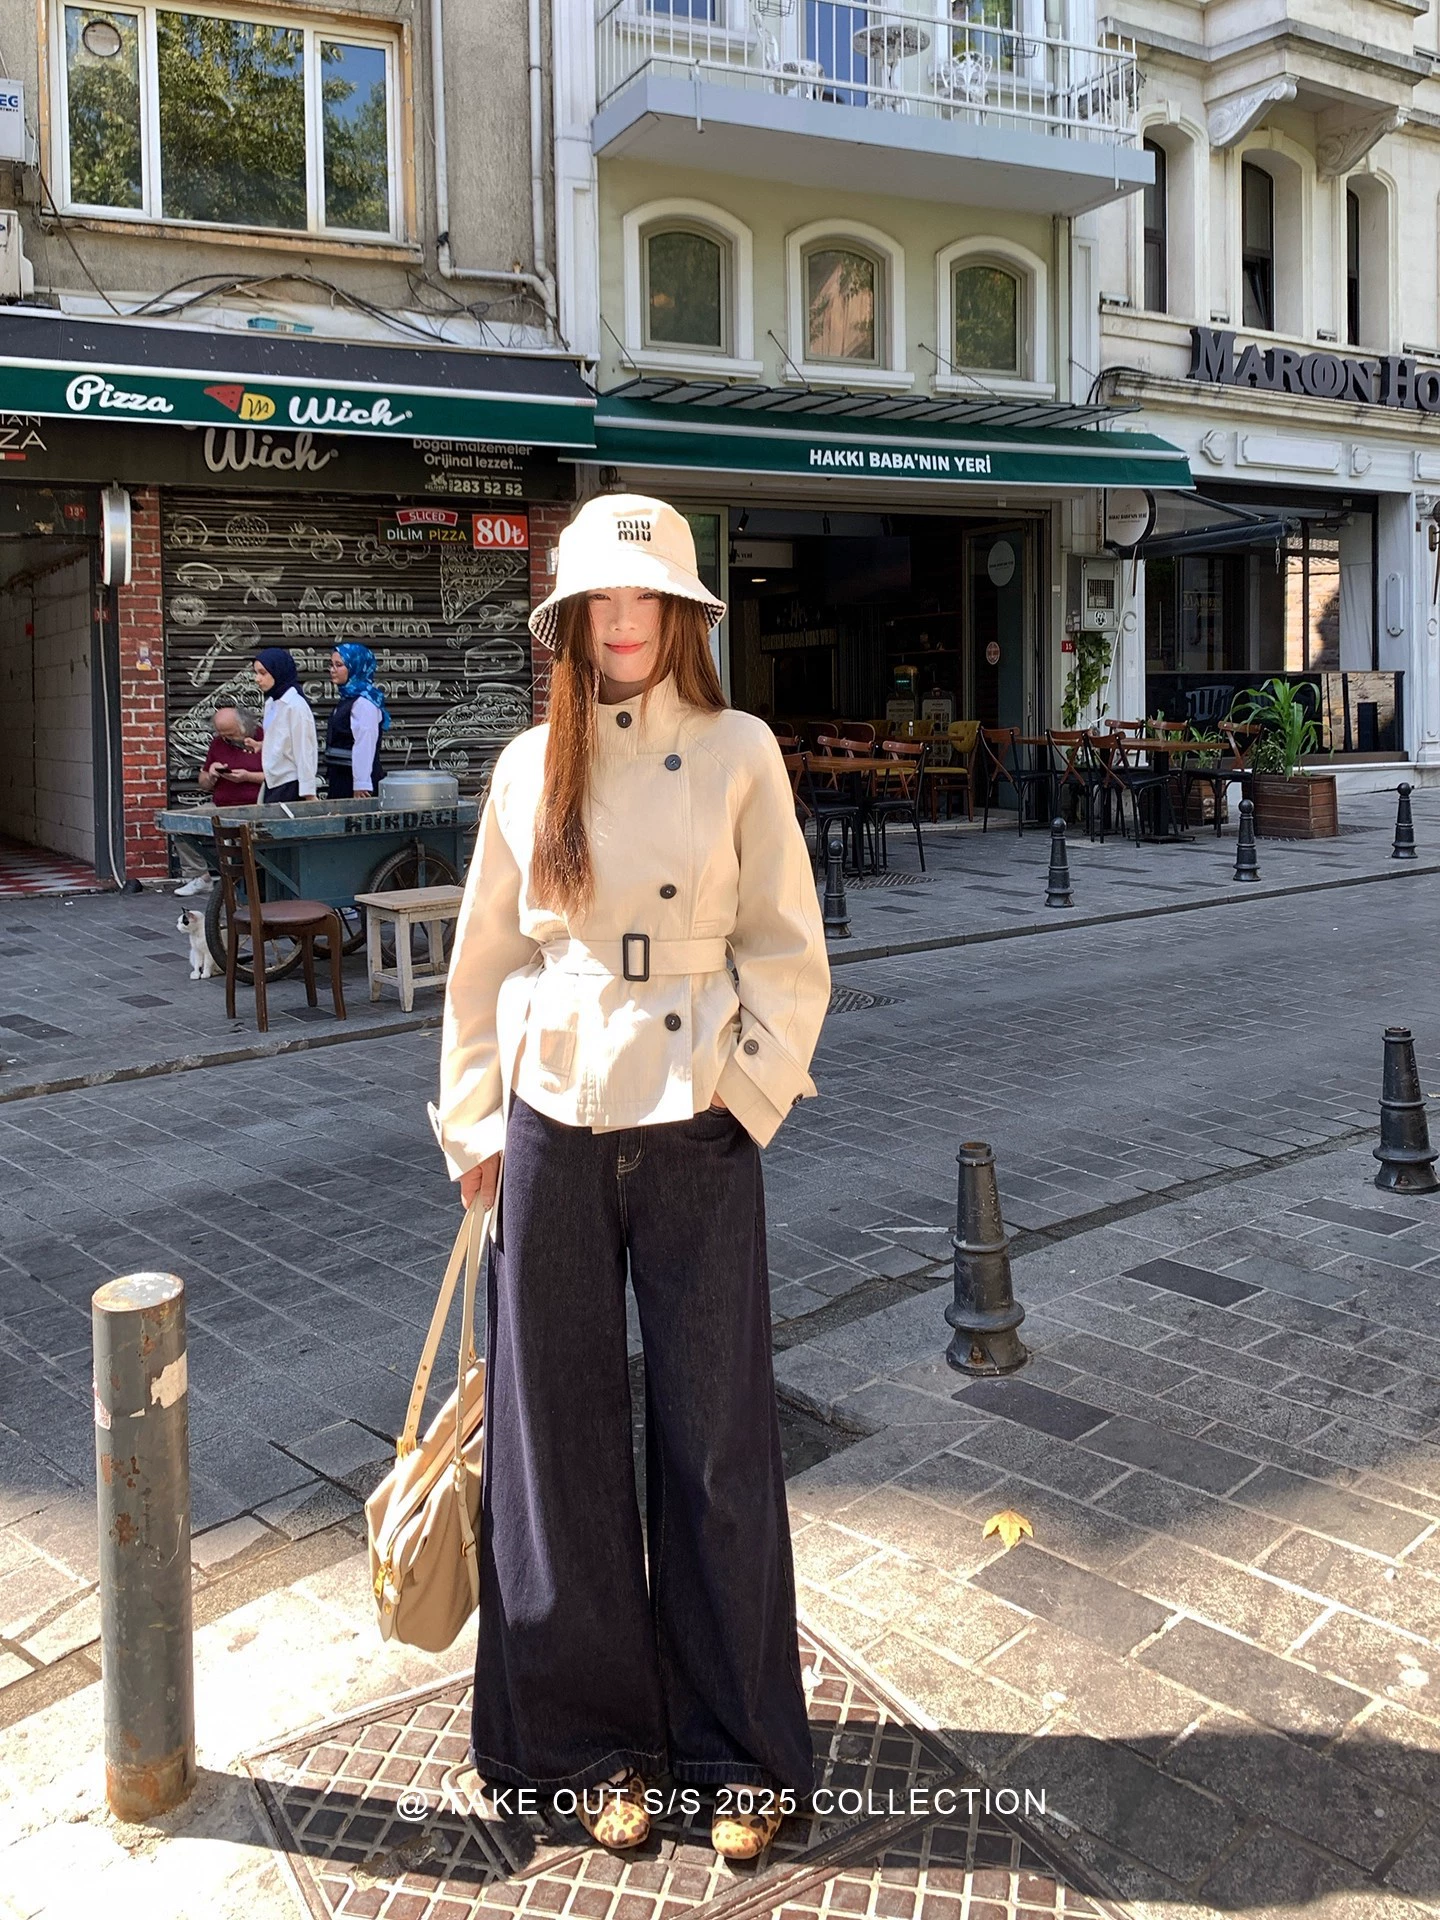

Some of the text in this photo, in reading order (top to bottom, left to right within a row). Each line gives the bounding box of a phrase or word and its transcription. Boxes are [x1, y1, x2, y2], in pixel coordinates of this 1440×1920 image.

[1187, 327, 1377, 404] MAROON
[65, 374, 174, 413] Pizza
[288, 396, 405, 426] Wich
[204, 427, 331, 473] Wich
[424, 453, 473, 469] Orijinal
[809, 449, 992, 474] HAKKI BABA'NIN YERİ
[454, 480, 480, 494] 283
[483, 482, 502, 495] 52
[505, 483, 523, 496] 52
[409, 511, 446, 522] SLICED
[617, 520, 651, 530] miu
[387, 528, 467, 541] DİLİM PİZZA
[618, 530, 652, 542] miu
[1065, 643, 1073, 651] 15
